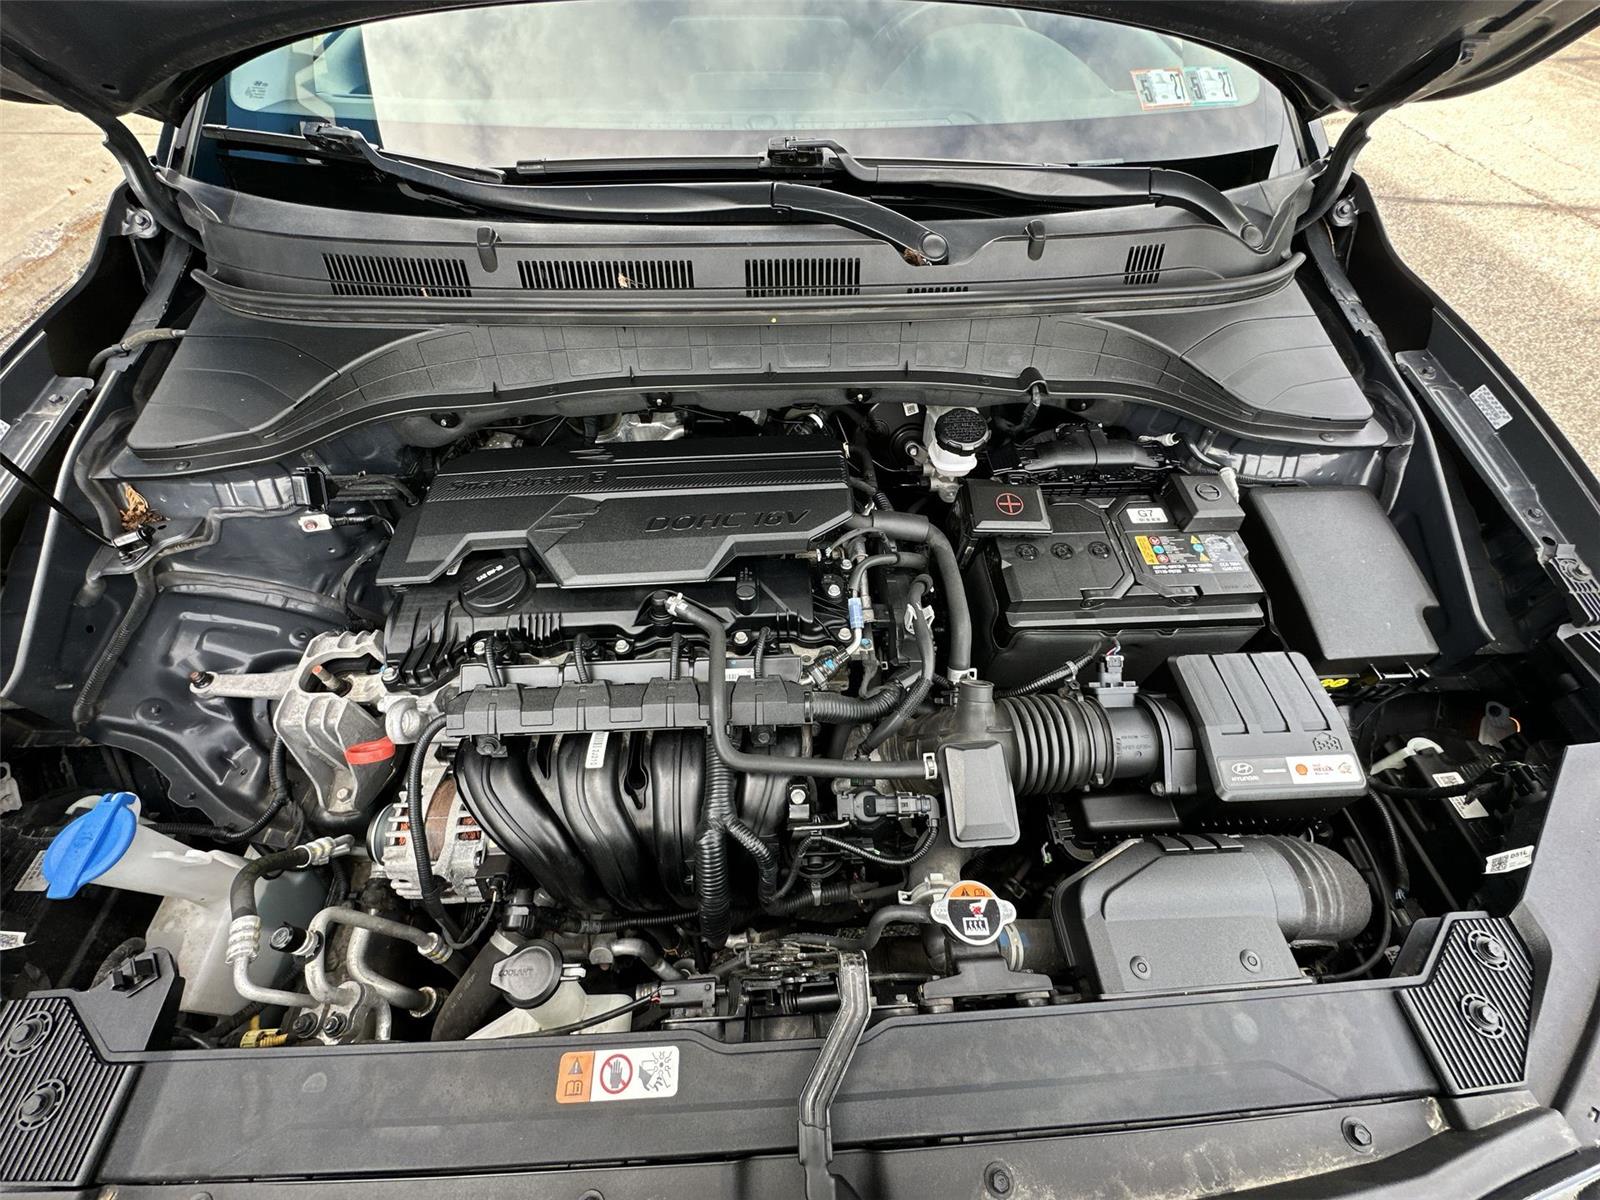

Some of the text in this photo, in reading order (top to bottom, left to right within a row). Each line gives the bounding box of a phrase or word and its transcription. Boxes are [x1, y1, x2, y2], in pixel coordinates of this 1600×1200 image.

[1141, 73, 1186, 103] 5 27
[1190, 72, 1233, 100] 5 27
[645, 508, 812, 533] DOHC 16V
[1137, 509, 1153, 518] G7
